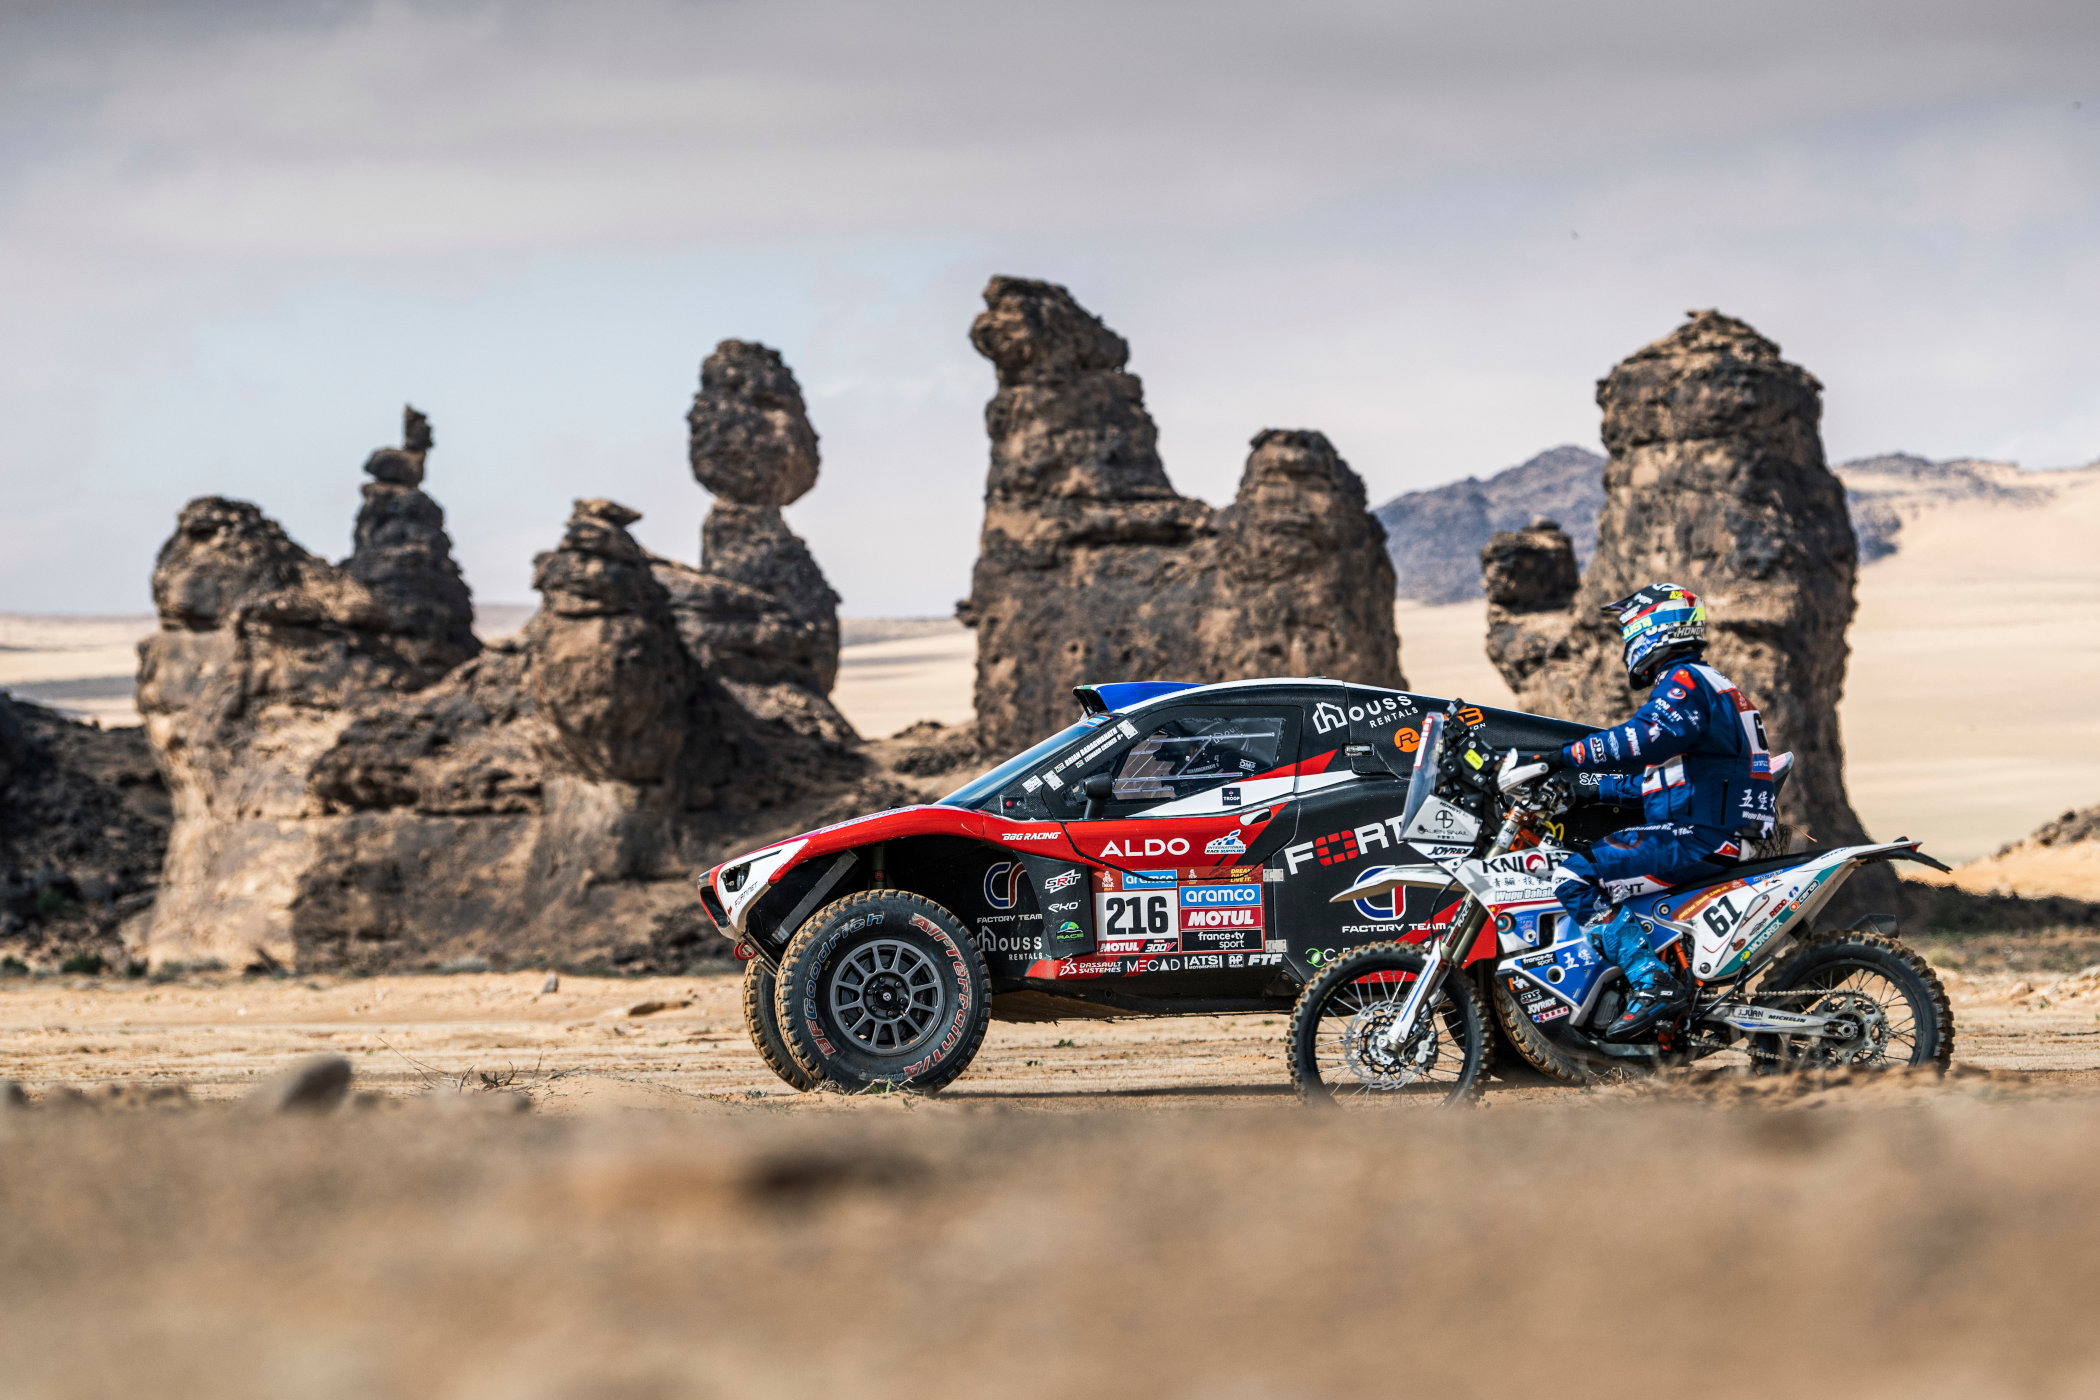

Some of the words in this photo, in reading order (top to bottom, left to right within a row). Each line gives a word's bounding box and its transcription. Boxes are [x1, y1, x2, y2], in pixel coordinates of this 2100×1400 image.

[1370, 706, 1419, 729] RENTALS
[1002, 832, 1023, 840] BBG
[1024, 832, 1061, 840] RACING
[1100, 838, 1190, 857] ALDO
[1427, 846, 1471, 855] JOYRIDE
[1185, 887, 1256, 903] aramco
[977, 915, 1015, 923] FACTORY
[1106, 896, 1169, 935] 216
[1187, 910, 1254, 926] MOTUL
[1702, 895, 1742, 938] 61
[1342, 924, 1404, 933] FACTORY
[1408, 922, 1446, 931] TEAM
[1750, 920, 1784, 955] MOTOREX
[1100, 942, 1139, 952] MOTUL
[1145, 942, 1177, 952] 300V
[1219, 940, 1245, 950] sport
[1008, 953, 1043, 961] RENTALS
[1248, 954, 1283, 966] FTF
[1127, 959, 1180, 972] MECAD
[803, 912, 885, 1057] BFGoodrich
[1528, 997, 1557, 1014] JOYRIDE
[1768, 1014, 1807, 1023] MICHELIN
